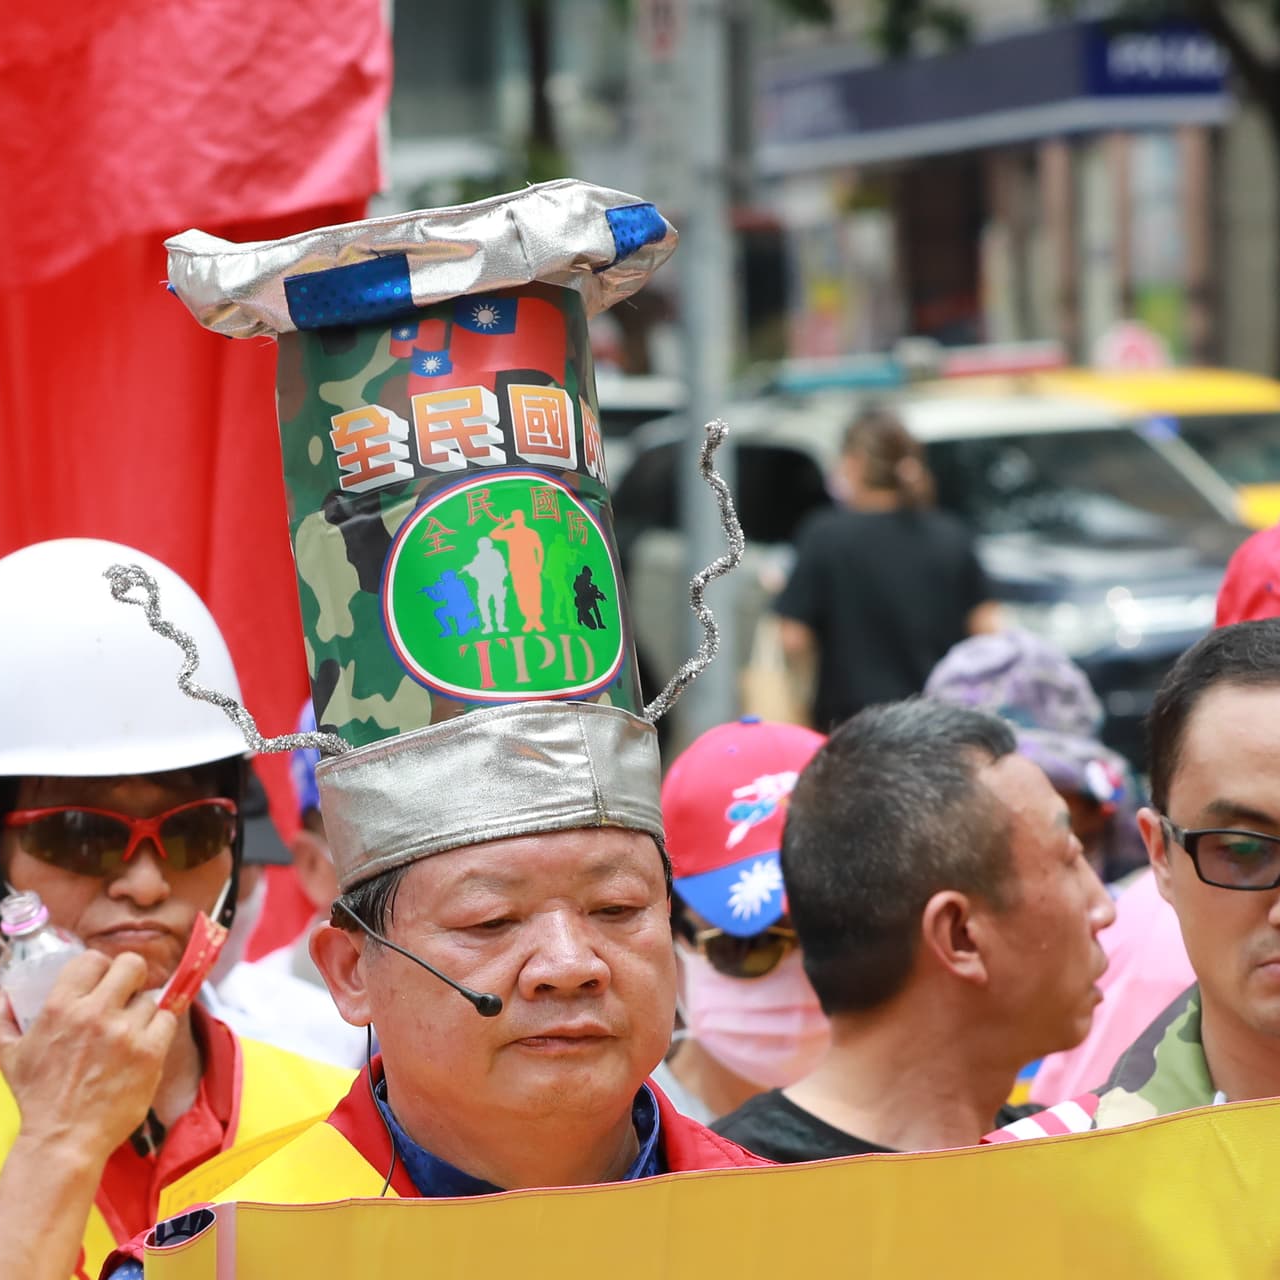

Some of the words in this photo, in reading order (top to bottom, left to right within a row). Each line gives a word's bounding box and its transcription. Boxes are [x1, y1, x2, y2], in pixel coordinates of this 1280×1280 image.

[420, 486, 588, 558] 全民國防
[459, 633, 596, 690] TPD
